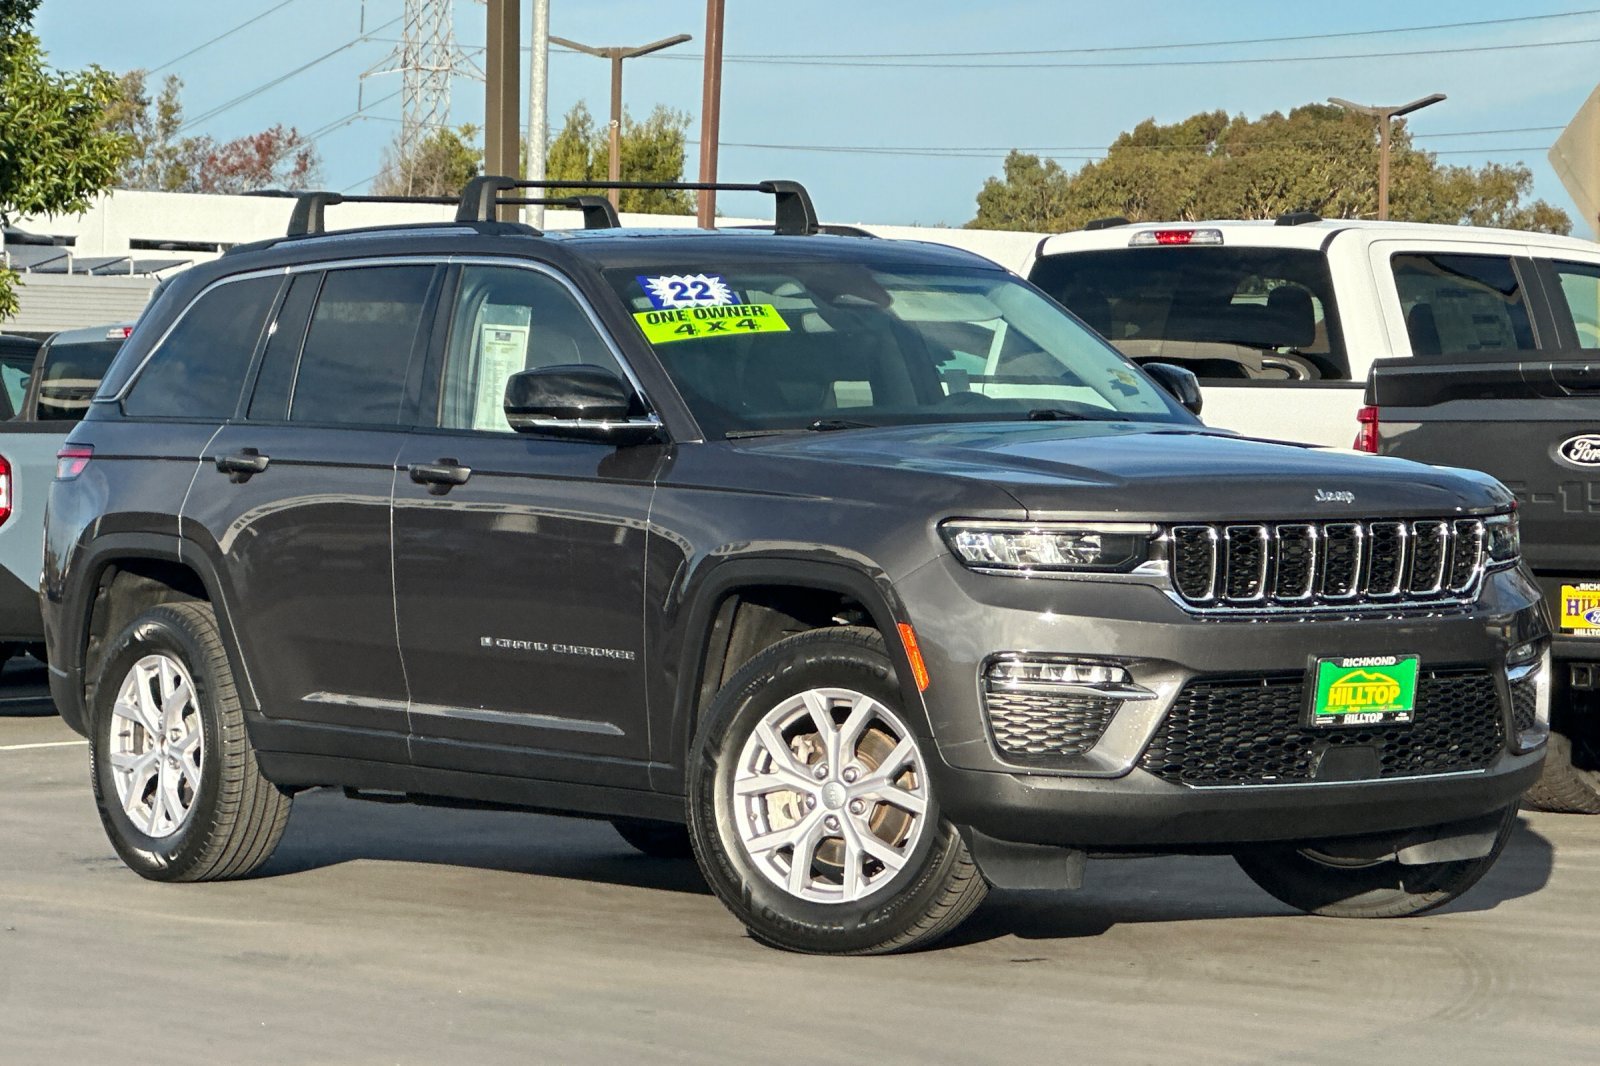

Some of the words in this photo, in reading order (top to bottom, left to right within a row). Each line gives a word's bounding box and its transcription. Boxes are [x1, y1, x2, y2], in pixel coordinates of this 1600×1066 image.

[668, 281, 715, 301] 22
[646, 309, 689, 325] ONE
[693, 305, 768, 320] OWNER
[1314, 488, 1355, 504] Jeep
[496, 638, 548, 651] GRAND
[552, 643, 636, 660] CHEROKEE
[1342, 656, 1397, 667] RICHMOND
[1327, 685, 1401, 706] HILLTOP
[1343, 712, 1384, 725] HILLTOP
